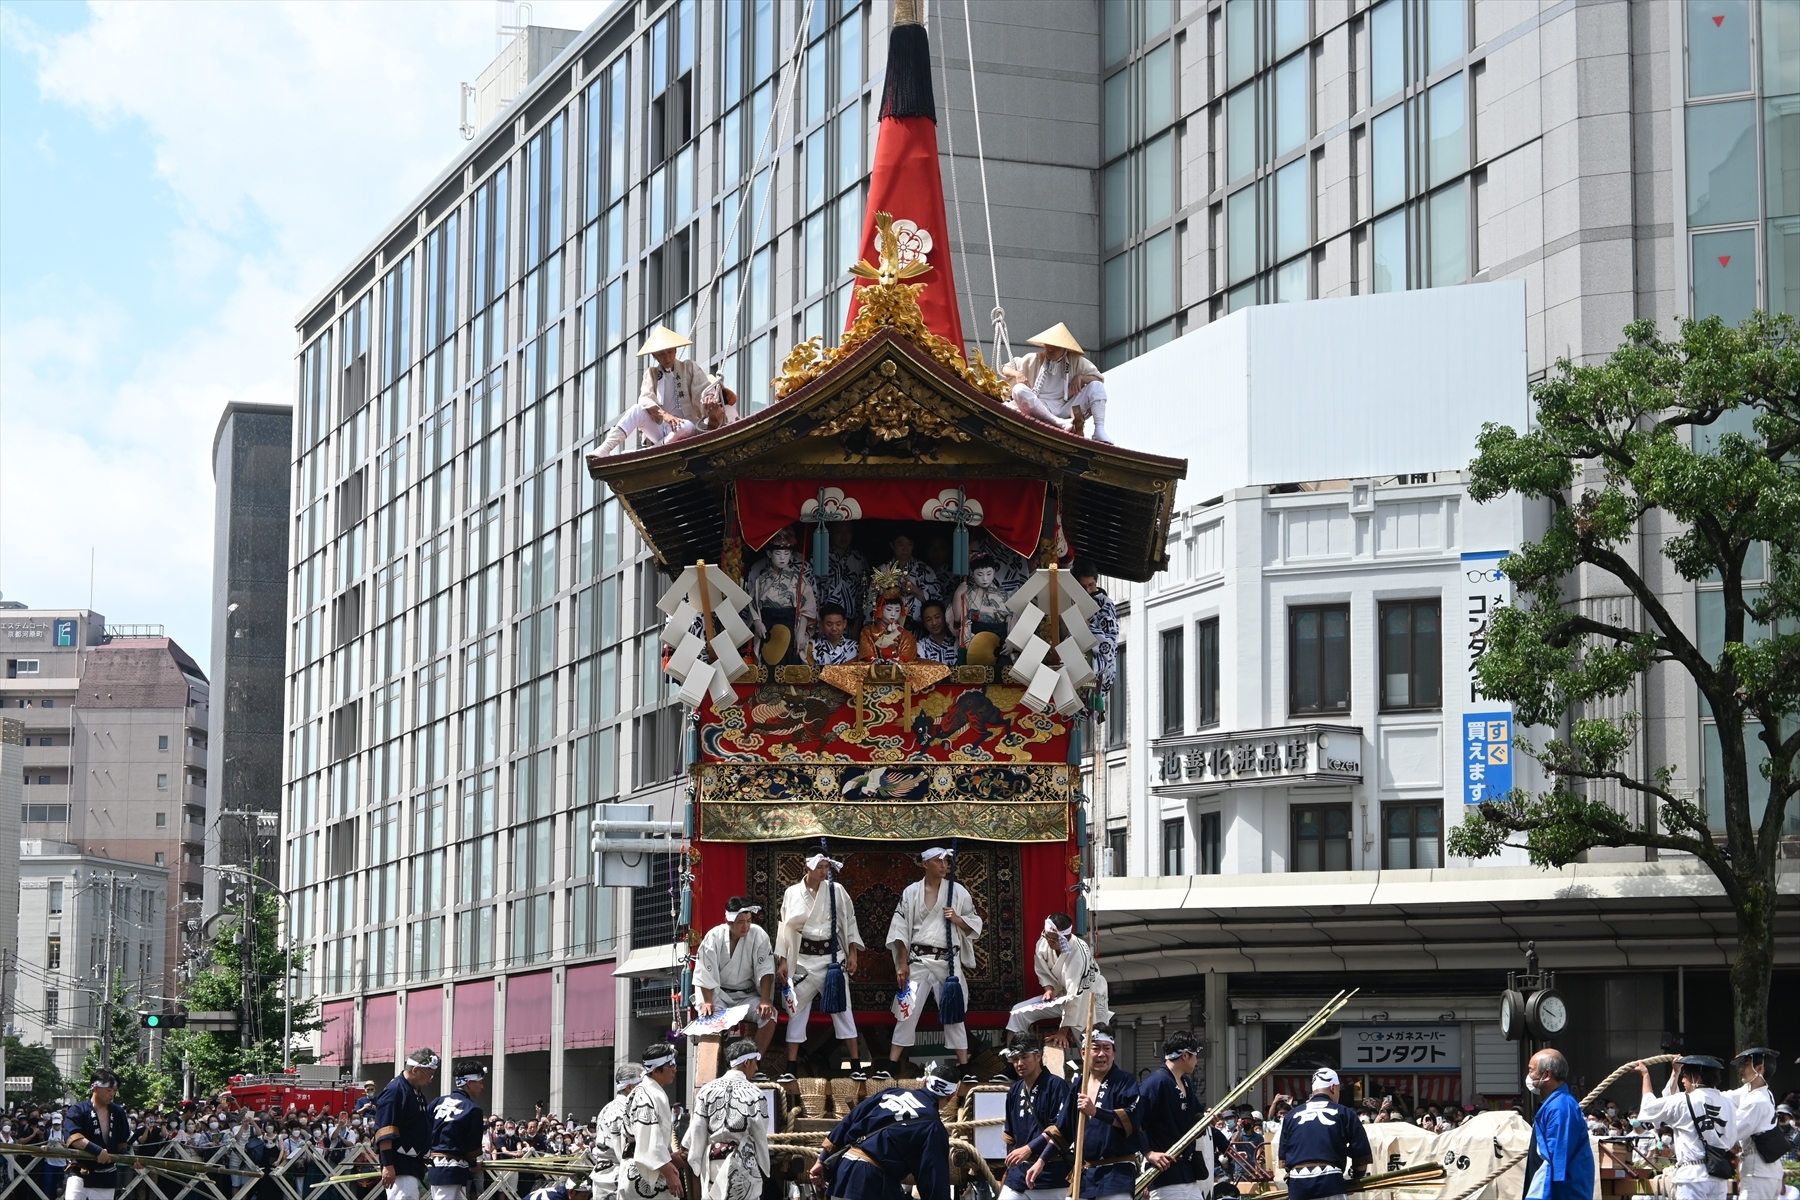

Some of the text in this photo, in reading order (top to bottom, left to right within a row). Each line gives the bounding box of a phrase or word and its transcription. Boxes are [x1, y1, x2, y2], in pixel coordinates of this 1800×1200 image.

[1, 622, 49, 630] エステムコート
[7, 630, 43, 638] 京都河原町
[1489, 722, 1506, 763] すぐ
[1159, 739, 1308, 781] 池善化粧品店
[1467, 721, 1486, 802] 買えます
[1386, 1031, 1446, 1041] メガネスーパー
[1357, 1045, 1446, 1063] コンタクト
